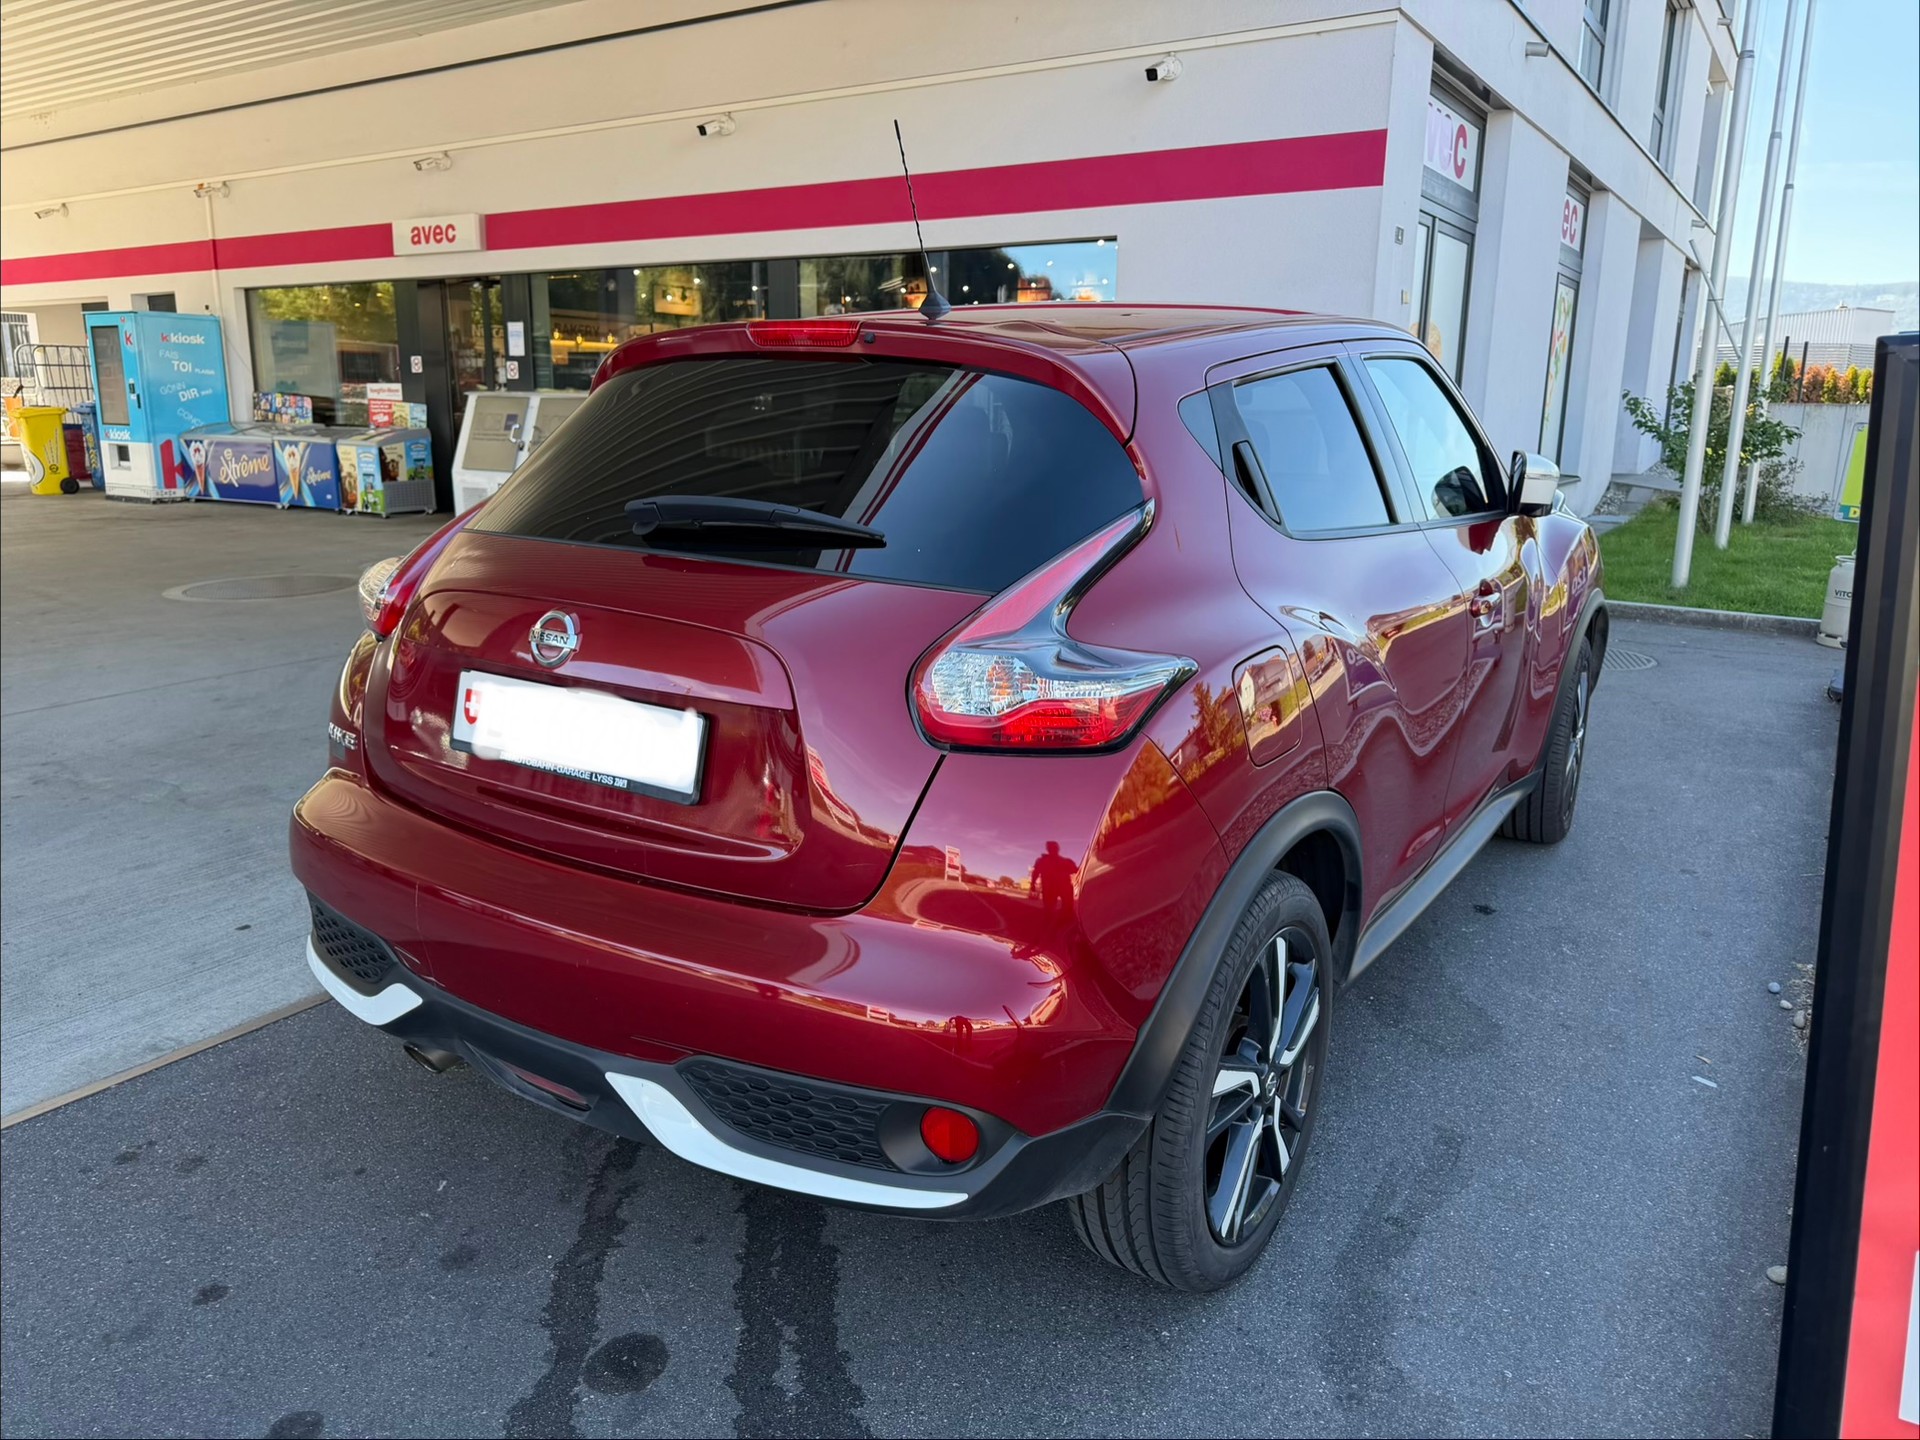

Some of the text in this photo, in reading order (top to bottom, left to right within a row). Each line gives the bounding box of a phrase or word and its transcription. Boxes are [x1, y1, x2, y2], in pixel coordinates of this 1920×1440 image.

[410, 223, 456, 246] avec
[170, 332, 205, 345] kiosk
[171, 360, 192, 373] TOI
[179, 387, 200, 402] DIR
[591, 773, 614, 786] LYSS
